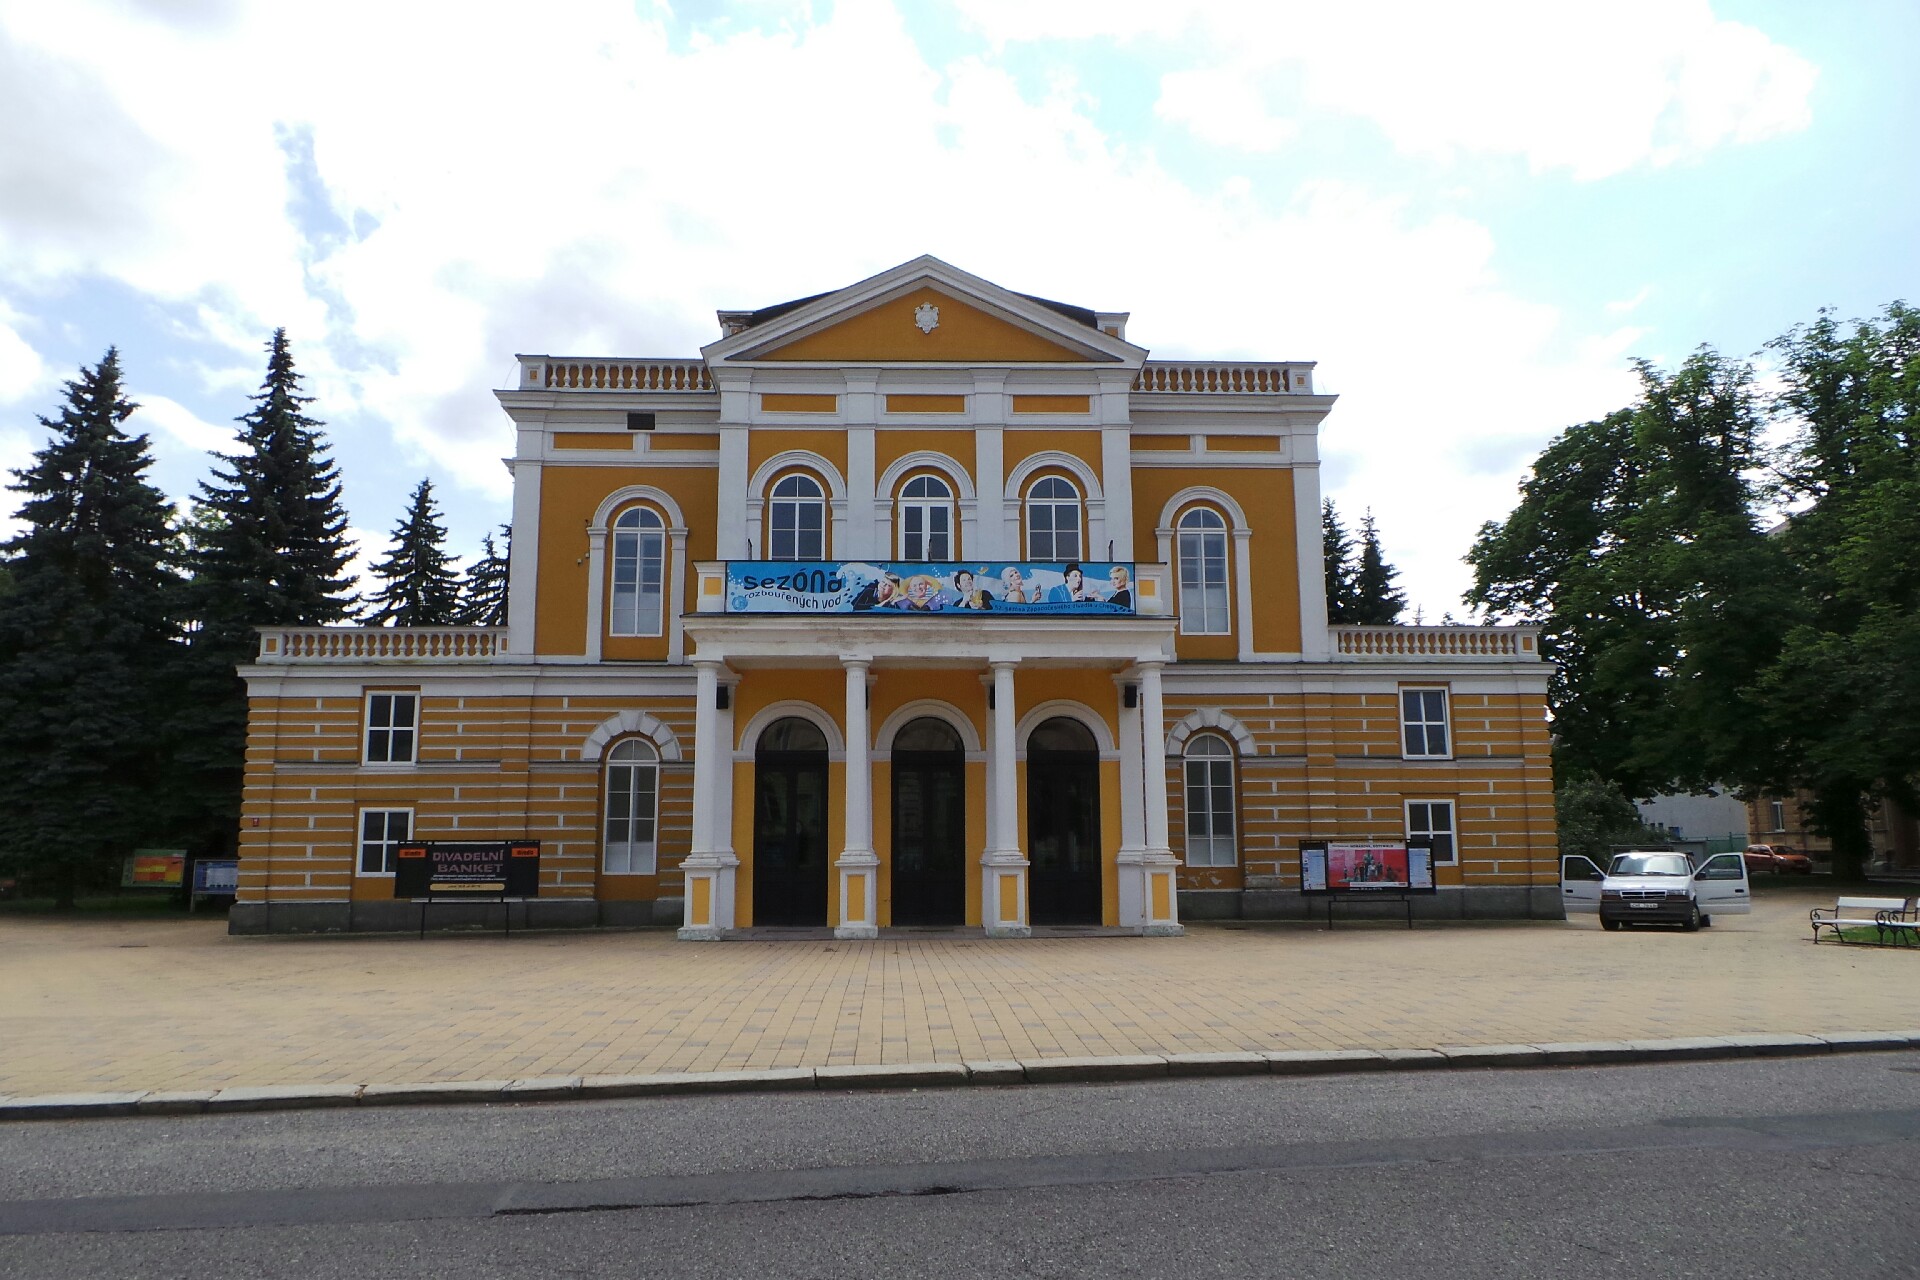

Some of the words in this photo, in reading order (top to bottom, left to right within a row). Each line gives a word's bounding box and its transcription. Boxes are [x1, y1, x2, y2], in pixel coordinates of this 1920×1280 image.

[744, 568, 842, 593] sezóna
[744, 590, 818, 609] rozbouřených
[821, 595, 842, 609] vod
[432, 850, 504, 862] DIVADELNÍ
[437, 863, 504, 873] BANKET
